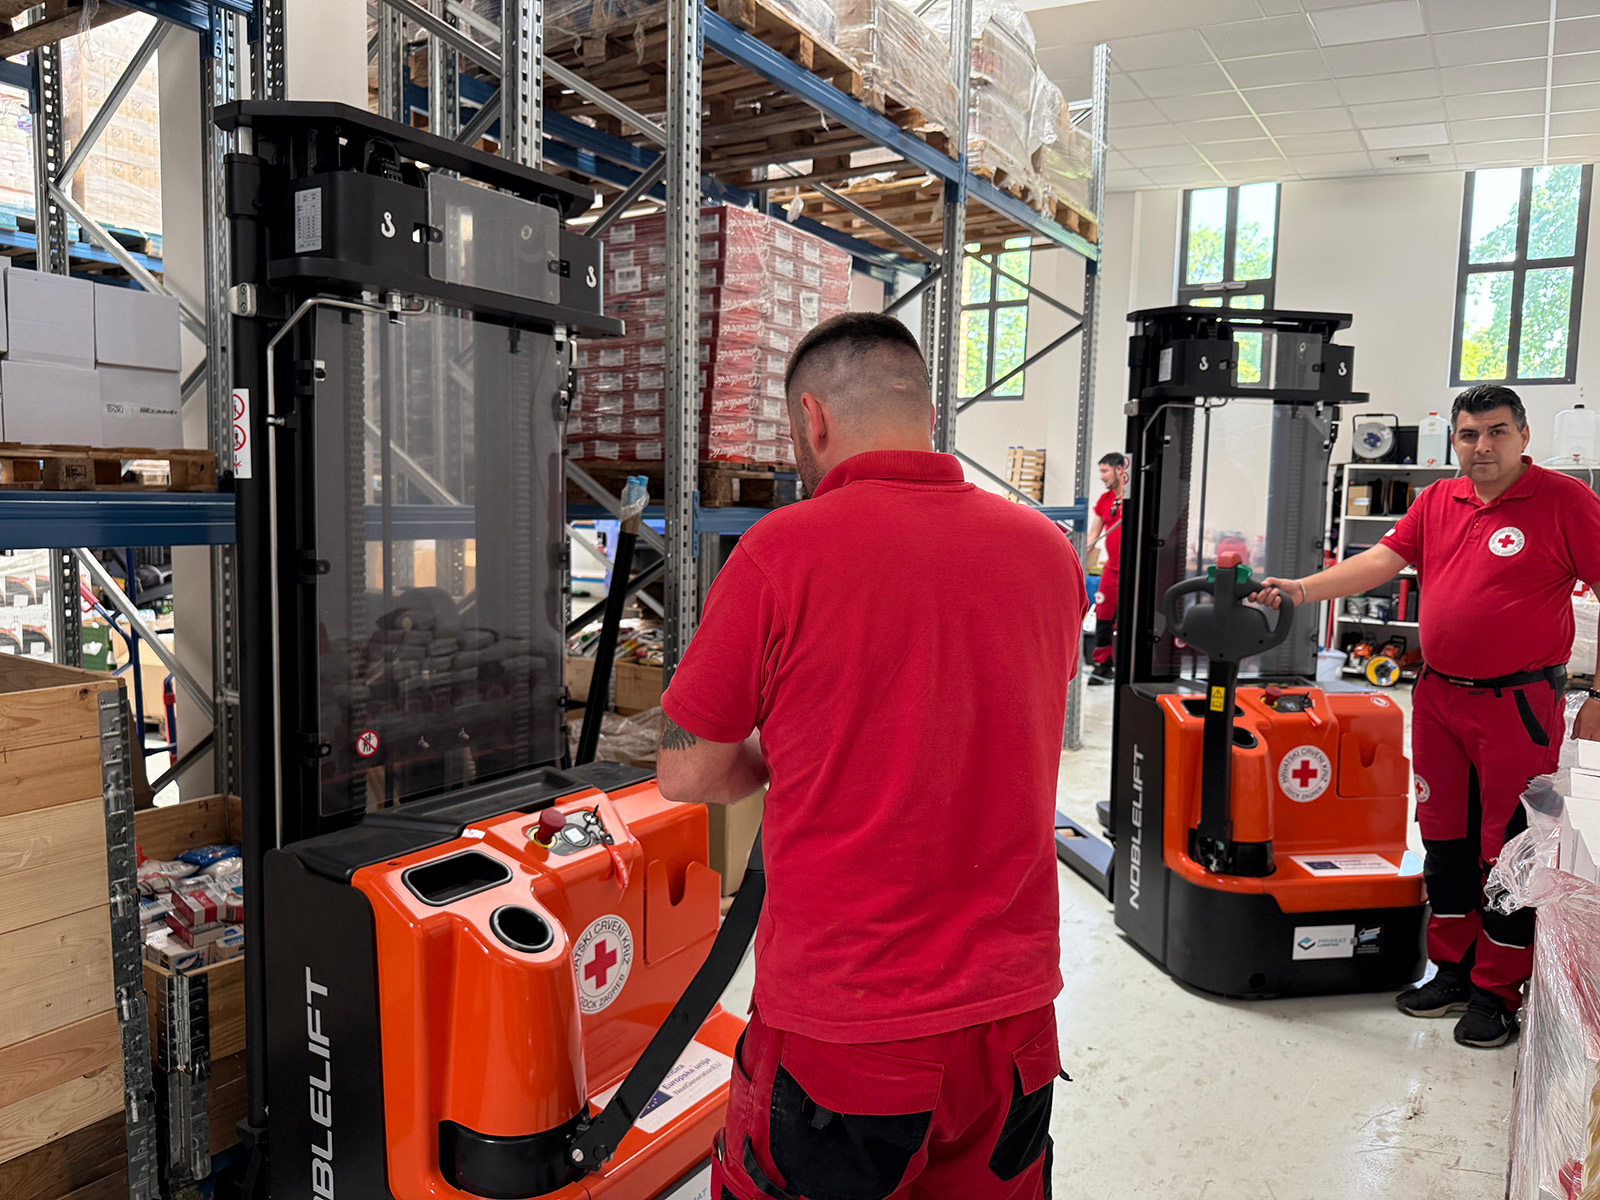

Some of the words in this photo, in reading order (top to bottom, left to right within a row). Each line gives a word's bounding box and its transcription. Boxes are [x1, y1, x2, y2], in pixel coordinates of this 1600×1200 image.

[1129, 743, 1144, 911] NOBLELIFT
[574, 931, 593, 972] ATSKI
[594, 919, 626, 938] CRVENI
[600, 973, 625, 1006] ZAGREB
[305, 966, 334, 1200] BLELIFT
[661, 1066, 696, 1090] Europska
[695, 1056, 712, 1071] unija
[673, 1061, 722, 1095] NextGenerationEU
